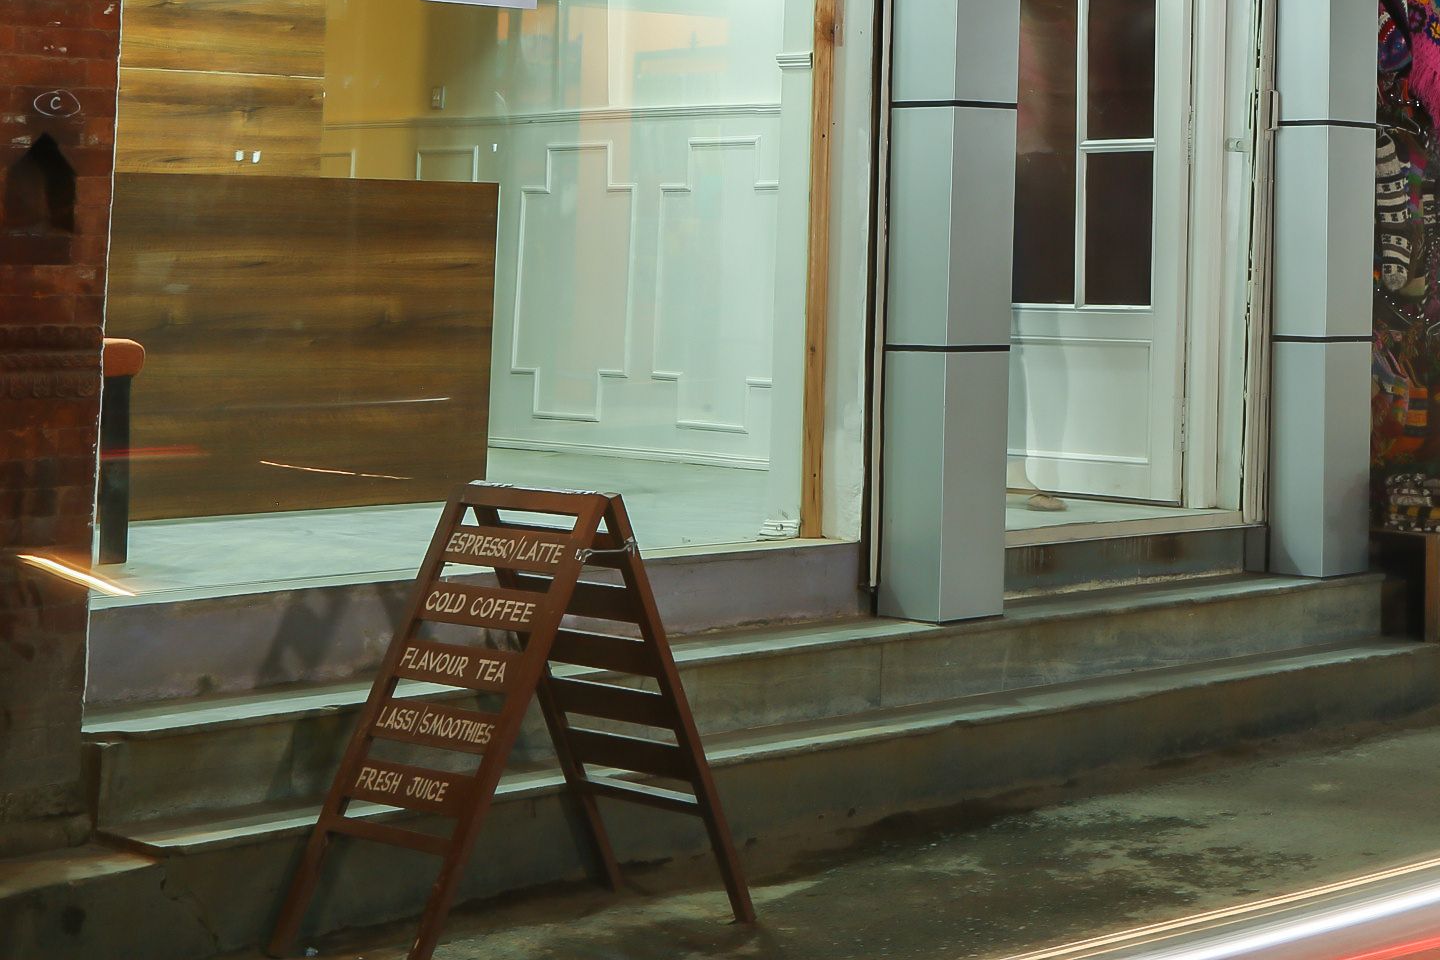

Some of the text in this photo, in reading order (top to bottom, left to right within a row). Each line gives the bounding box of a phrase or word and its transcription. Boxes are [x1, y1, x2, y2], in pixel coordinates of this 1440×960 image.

[445, 532, 565, 564] ESPRESSO/LATTE
[426, 590, 536, 624] COLD COFFEE
[399, 646, 507, 684] FLAVOUR TEA
[376, 705, 495, 745] LASSI/SMOOTHIES
[355, 766, 450, 803] FRESH JUICE
